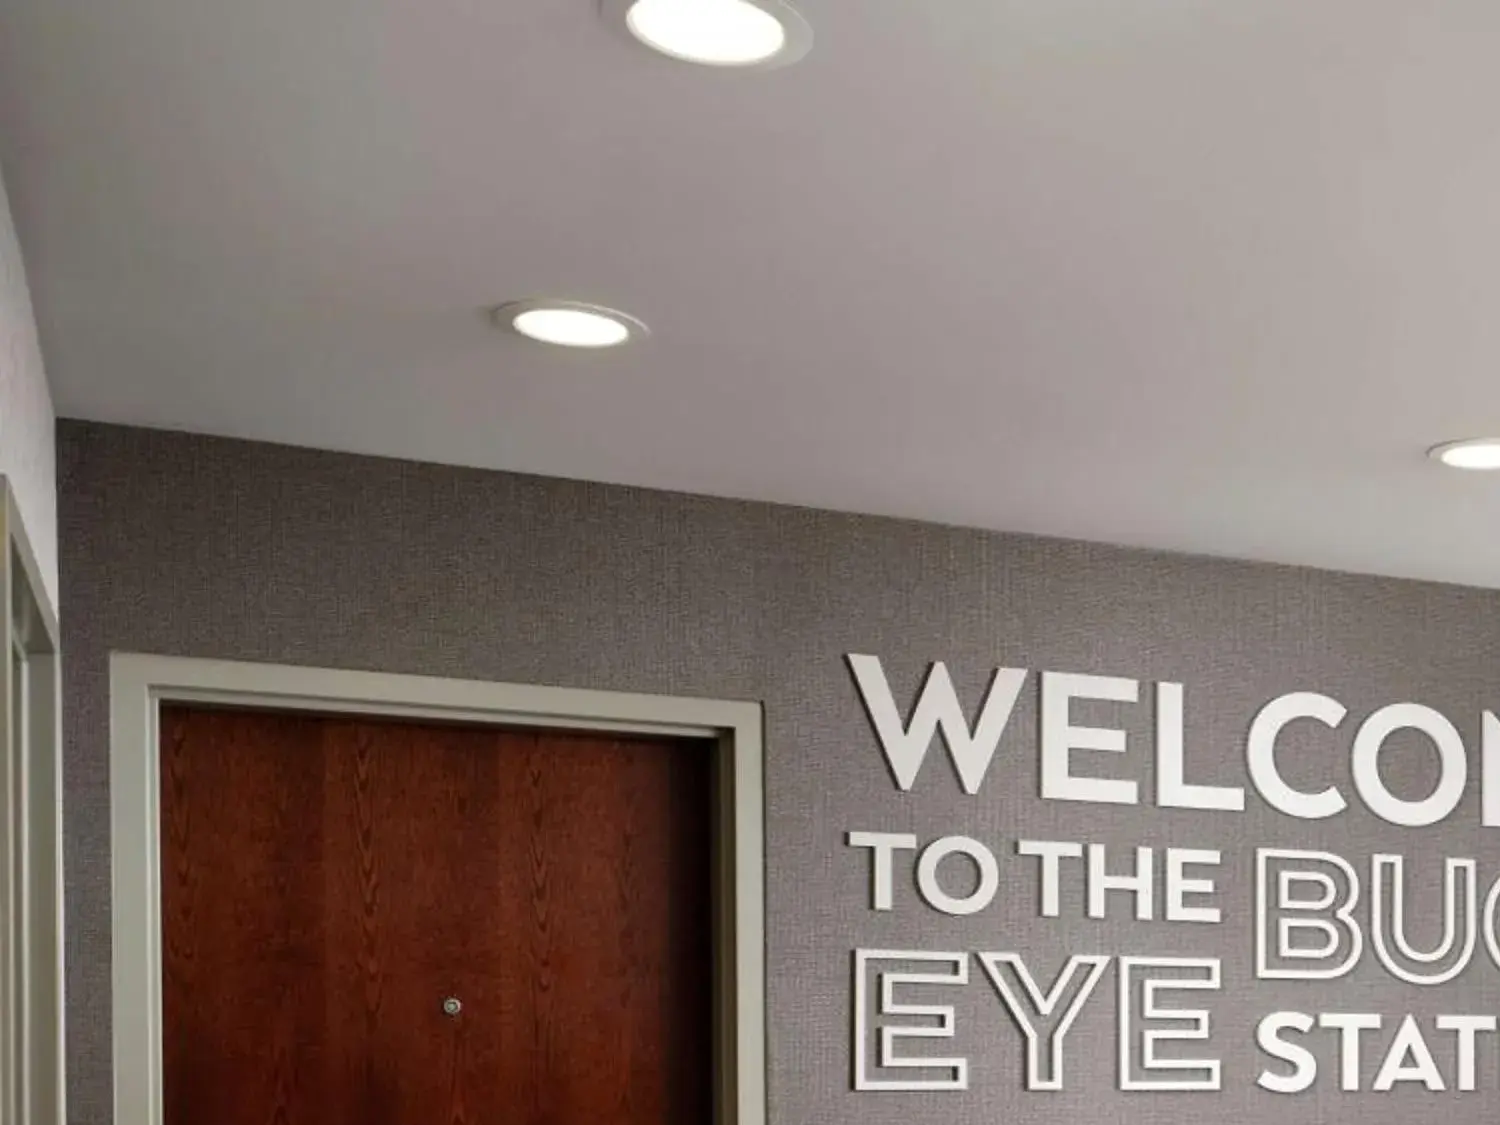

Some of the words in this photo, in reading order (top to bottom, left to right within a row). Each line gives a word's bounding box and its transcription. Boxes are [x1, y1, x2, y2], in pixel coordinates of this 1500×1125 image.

[848, 831, 1000, 916] TO
[1017, 840, 1223, 923] THE
[854, 948, 1223, 1093] EYE
